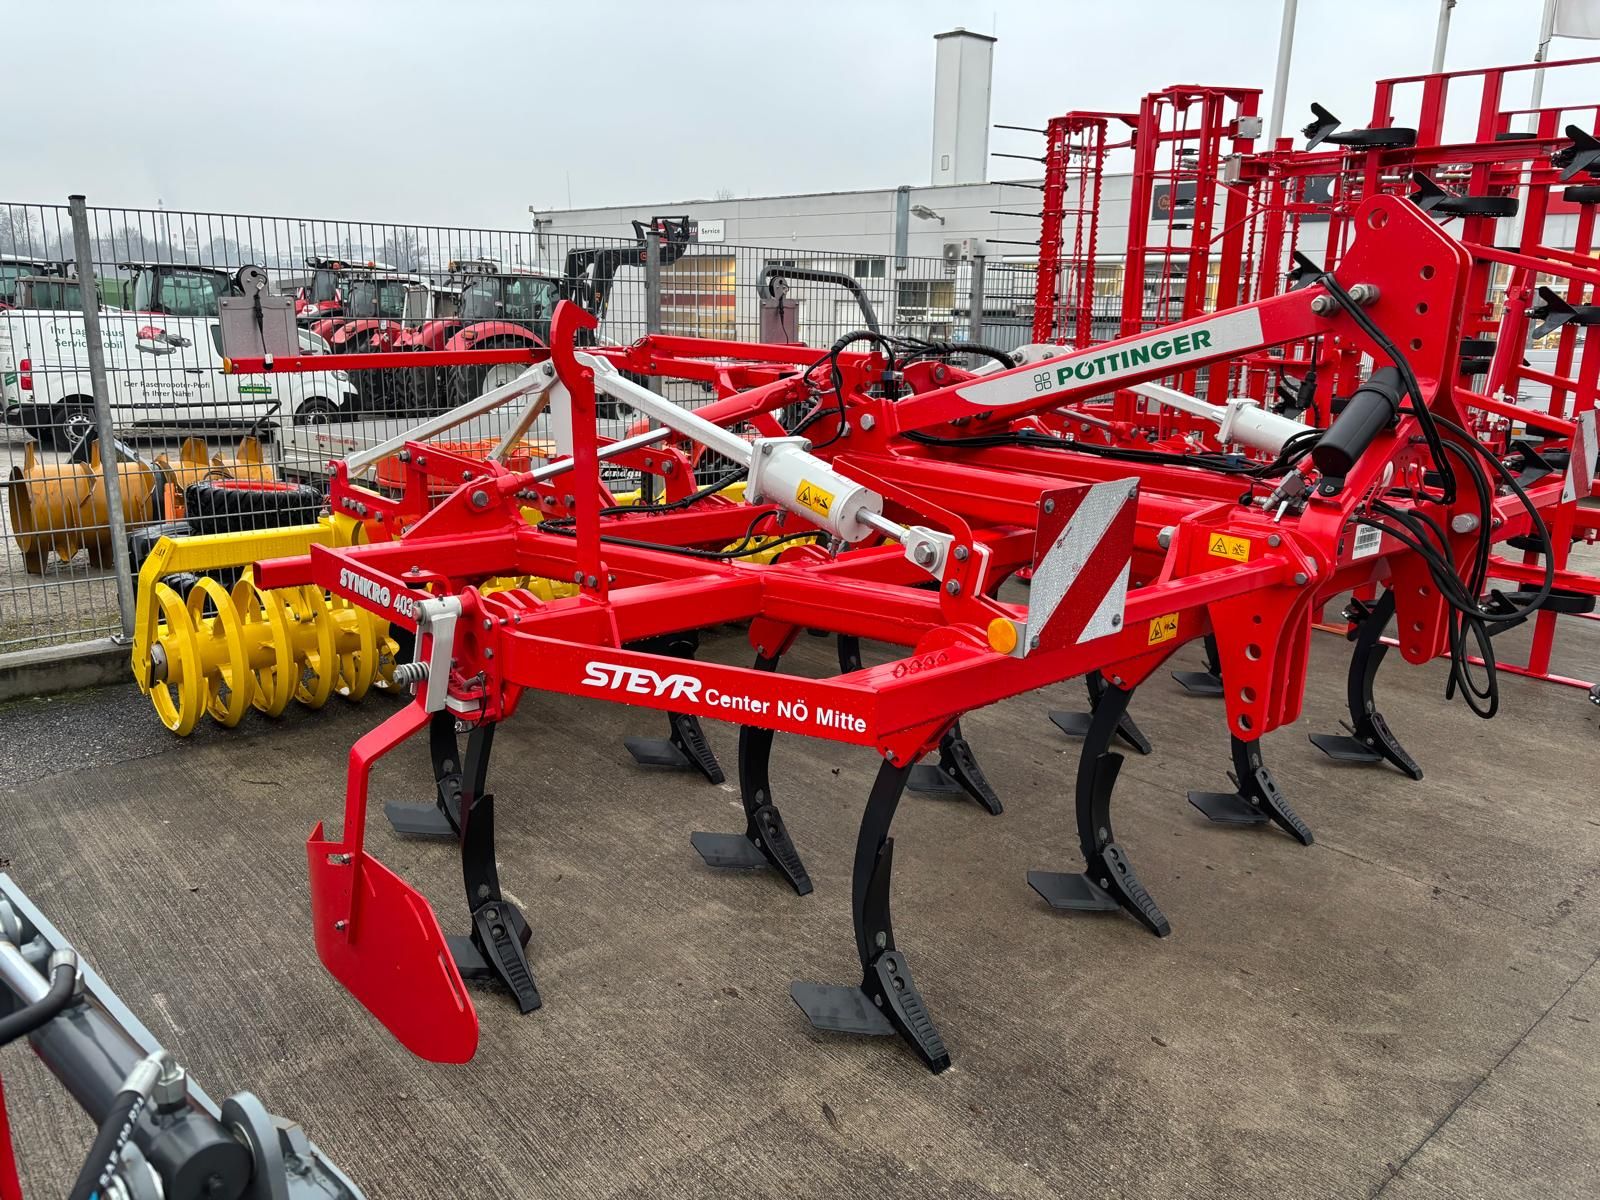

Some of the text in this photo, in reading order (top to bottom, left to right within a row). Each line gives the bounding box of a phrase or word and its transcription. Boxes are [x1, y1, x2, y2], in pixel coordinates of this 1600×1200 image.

[55, 339, 123, 349] Servicobil
[1057, 329, 1212, 385] PÖTTINGER
[340, 567, 391, 607] SYNKRO
[581, 661, 867, 733] STEYR Center NÖ Mitte
